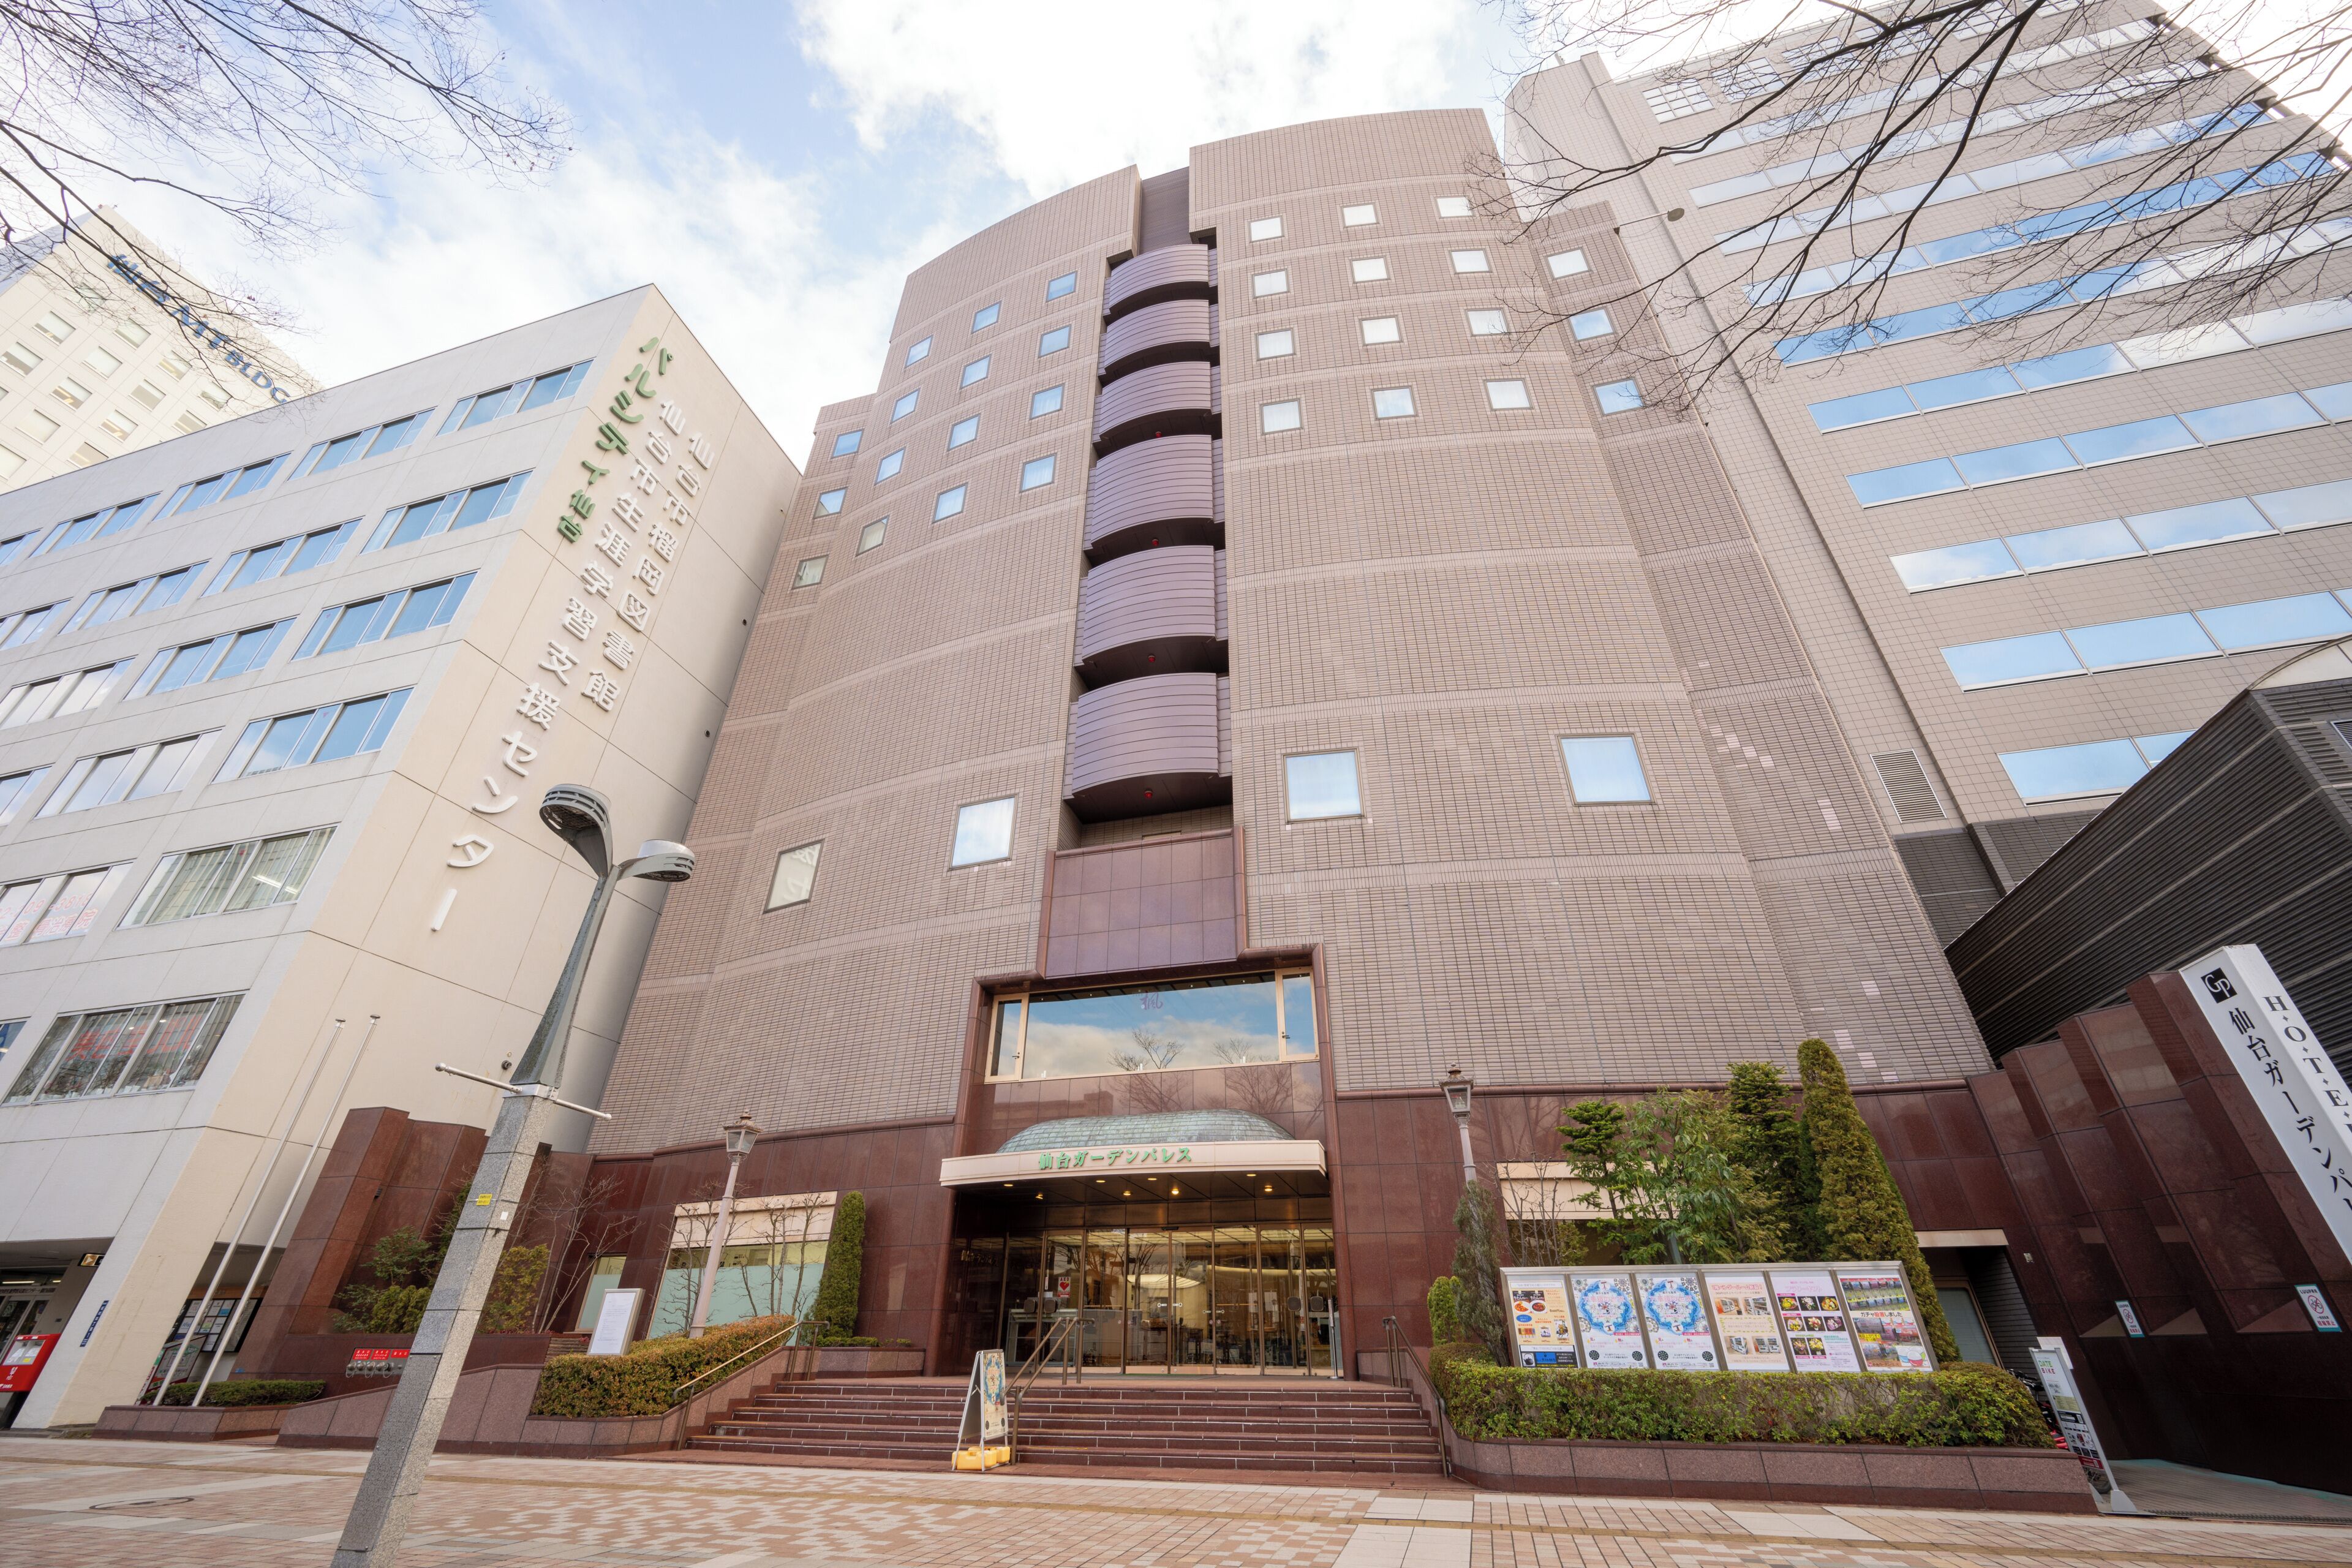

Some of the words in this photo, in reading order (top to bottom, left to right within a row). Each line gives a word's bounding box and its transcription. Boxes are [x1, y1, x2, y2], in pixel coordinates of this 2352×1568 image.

[557, 336, 674, 543] パルシティ仙台
[430, 398, 687, 932] 仙台市生涯学習支援センター
[581, 431, 715, 712] 仙台市榴岡図書館
[1039, 1147, 1191, 1170] 仙台ガーデンパレス
